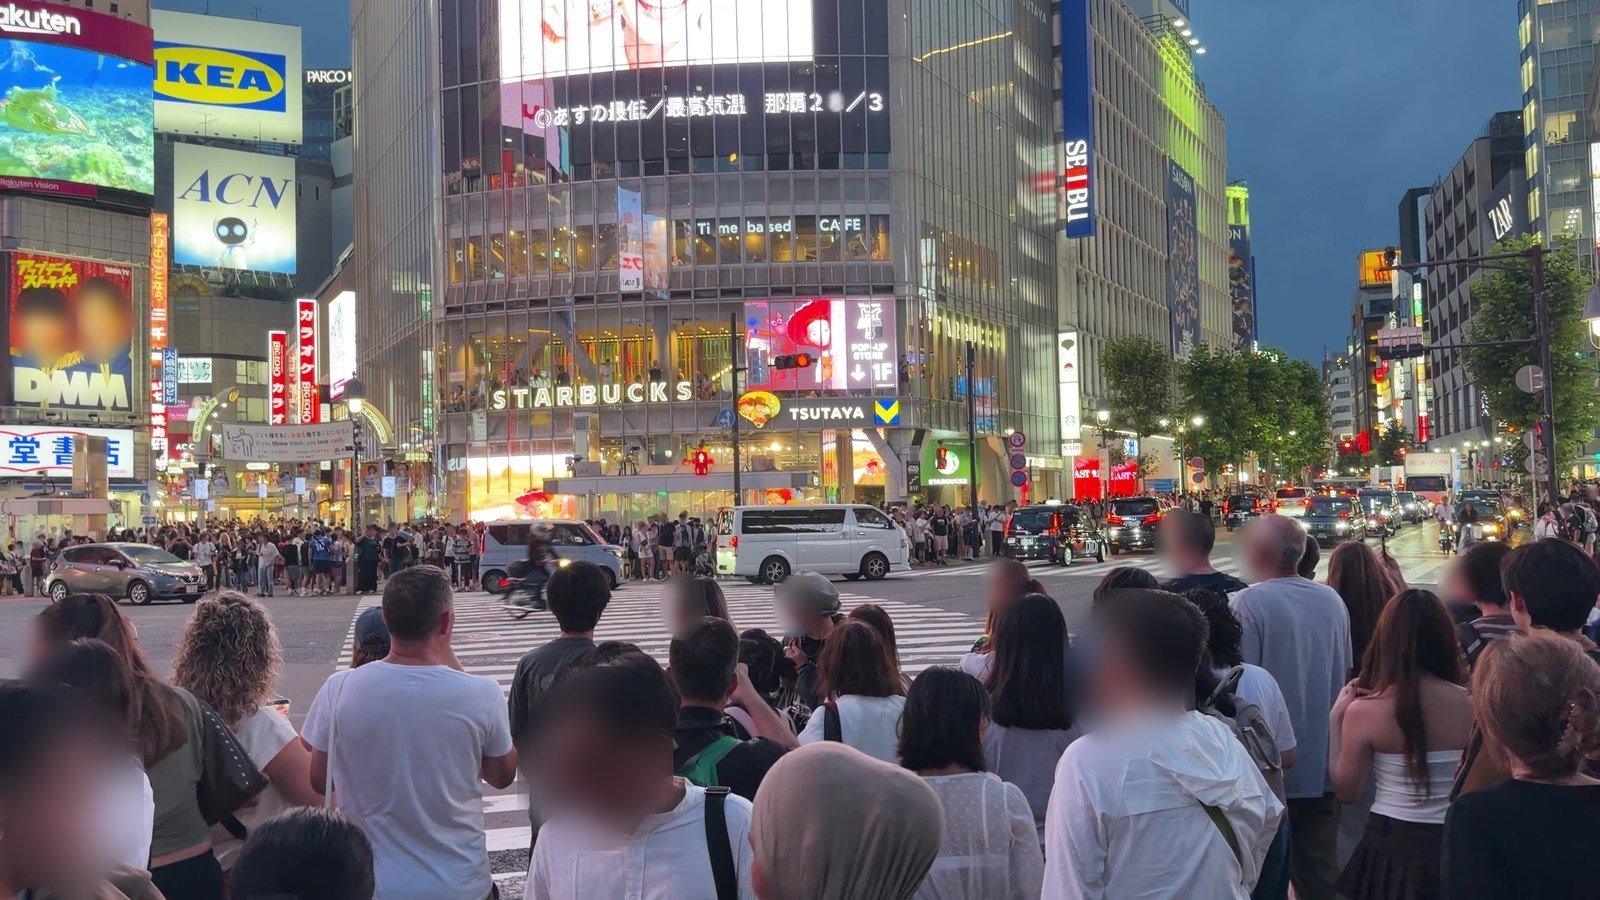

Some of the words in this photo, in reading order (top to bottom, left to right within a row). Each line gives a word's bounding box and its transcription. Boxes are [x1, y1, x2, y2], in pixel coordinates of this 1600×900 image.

[154, 59, 273, 92] KEA
[307, 70, 346, 83] PARCO
[0, 178, 33, 189] Rakuten
[34, 181, 60, 190] Vision
[177, 169, 292, 210] ACN
[1065, 139, 1089, 223] SEIBU
[697, 222, 738, 235] Time
[747, 220, 792, 233] based
[819, 218, 861, 232] CAFE
[300, 309, 315, 374] カラオケ
[872, 362, 893, 381] 1F
[14, 366, 129, 408] DMM
[493, 381, 692, 409] STARBUCKS
[789, 406, 865, 420] TSUTAYA
